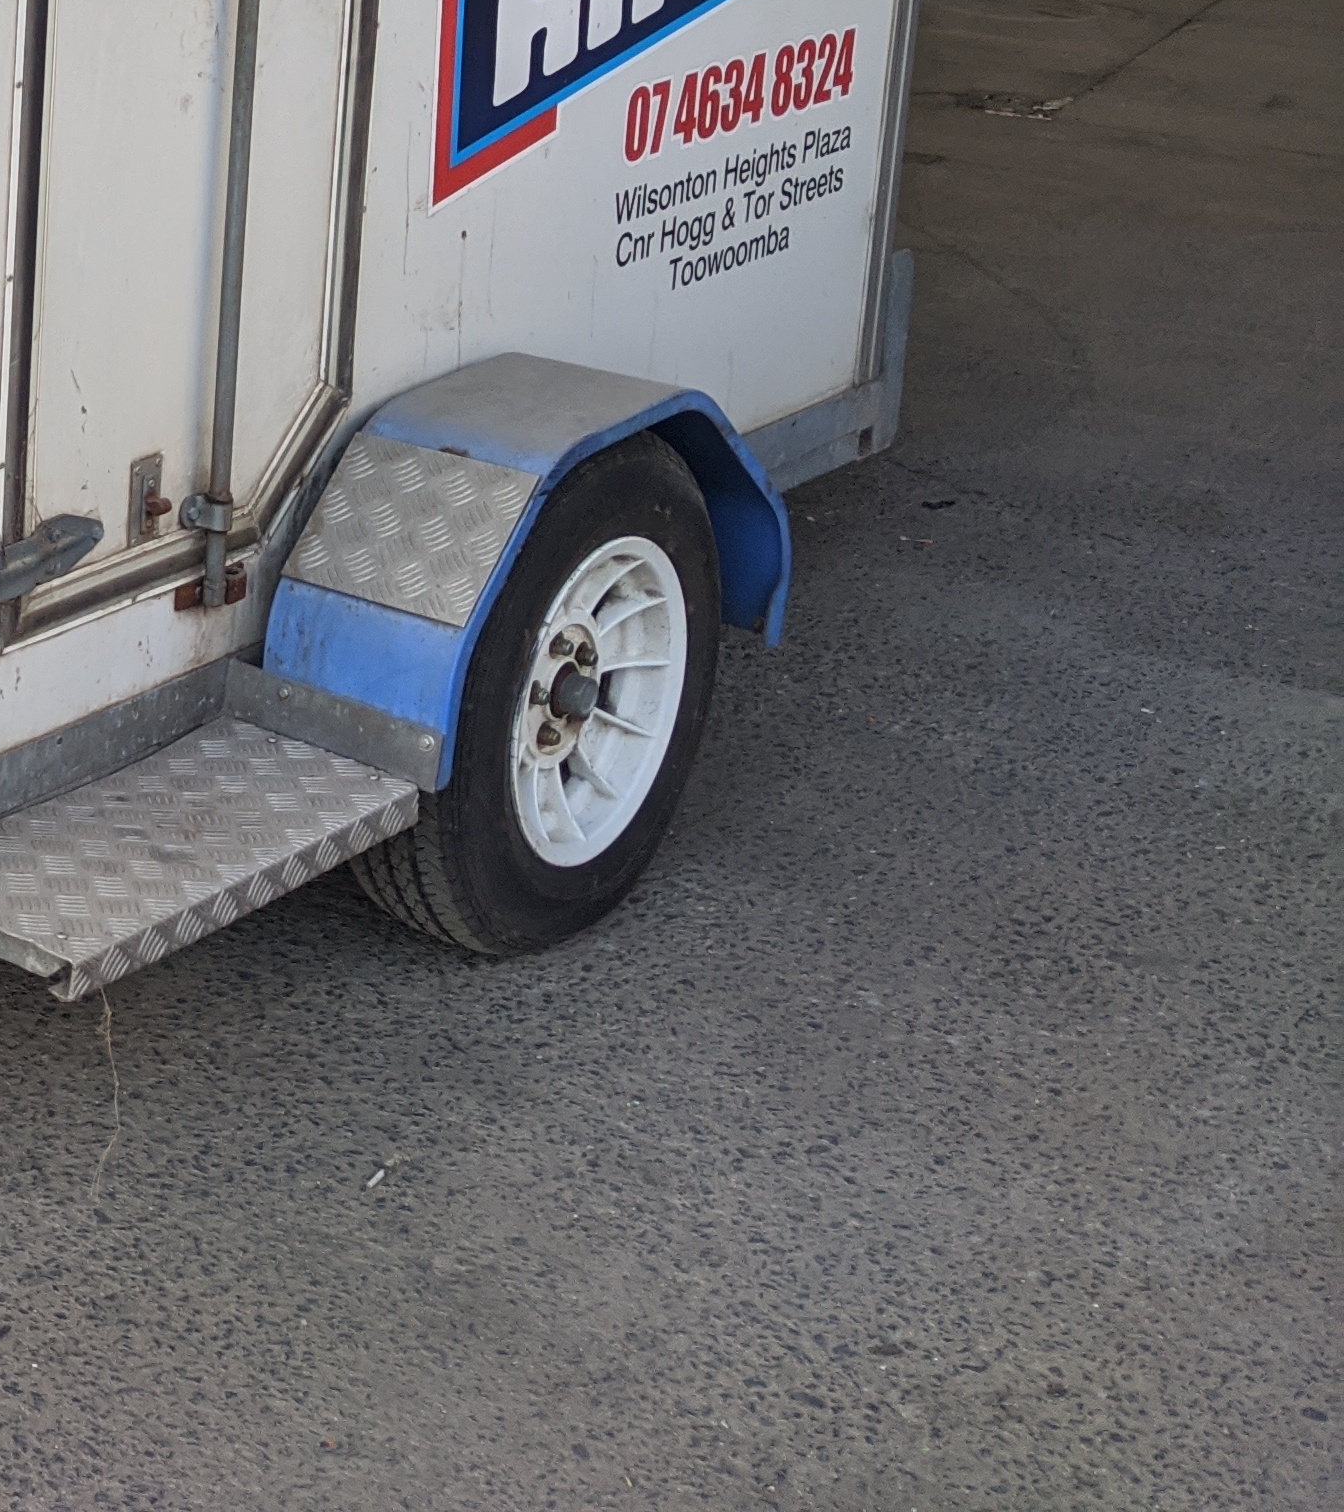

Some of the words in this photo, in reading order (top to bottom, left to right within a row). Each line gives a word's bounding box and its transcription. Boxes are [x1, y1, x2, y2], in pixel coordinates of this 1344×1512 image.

[624, 79, 672, 163] 07
[673, 52, 767, 145] 4634
[770, 27, 857, 117] 8324
[615, 168, 717, 225] Wilsonton
[723, 140, 797, 190] Heights
[801, 125, 851, 164] Plaza
[616, 229, 655, 268] Cnr
[659, 210, 716, 253] Hogg
[721, 196, 736, 231] &
[742, 188, 775, 224] Tor
[779, 164, 844, 211] Streets
[668, 224, 790, 291] Toowoomba
